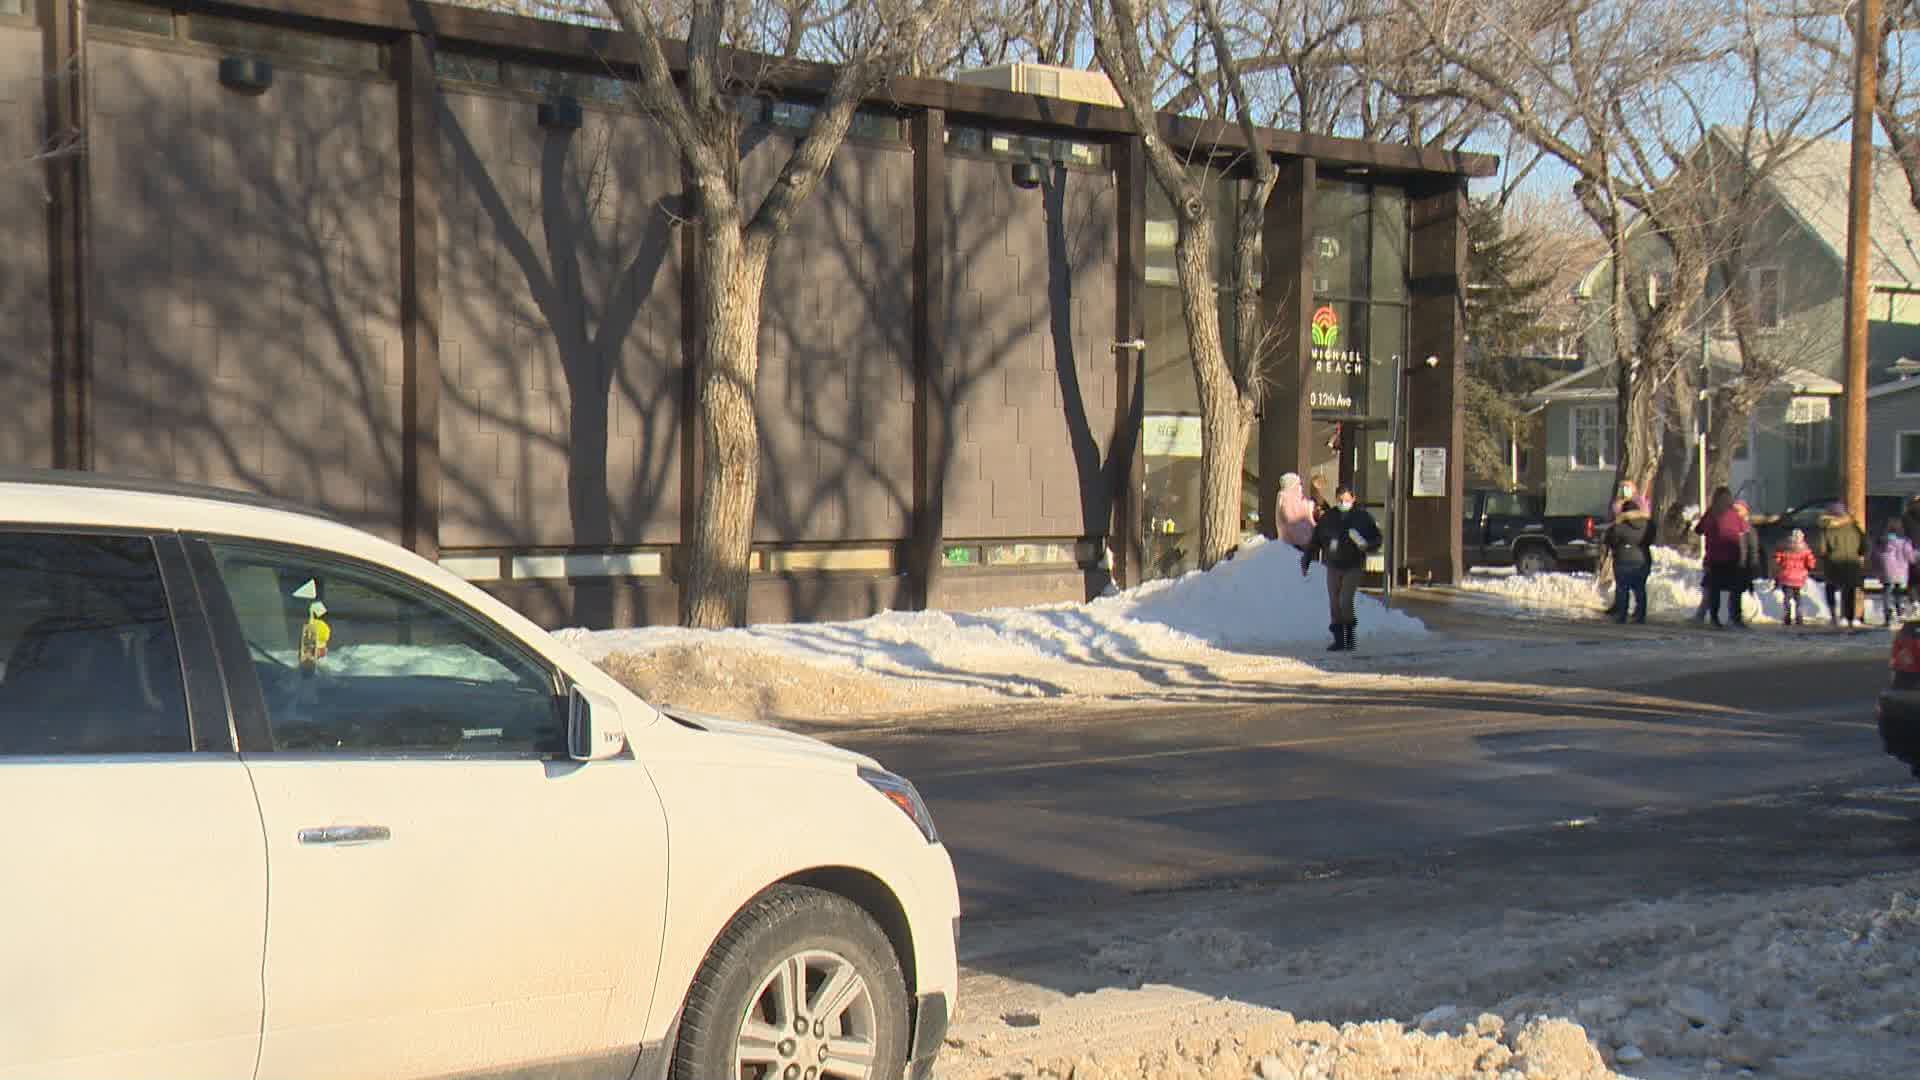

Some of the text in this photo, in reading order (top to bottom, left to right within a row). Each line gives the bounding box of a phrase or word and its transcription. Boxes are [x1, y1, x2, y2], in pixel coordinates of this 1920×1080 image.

[1316, 360, 1361, 376] REACH
[1318, 392, 1335, 407] 12th
[1337, 392, 1352, 408] Ave
